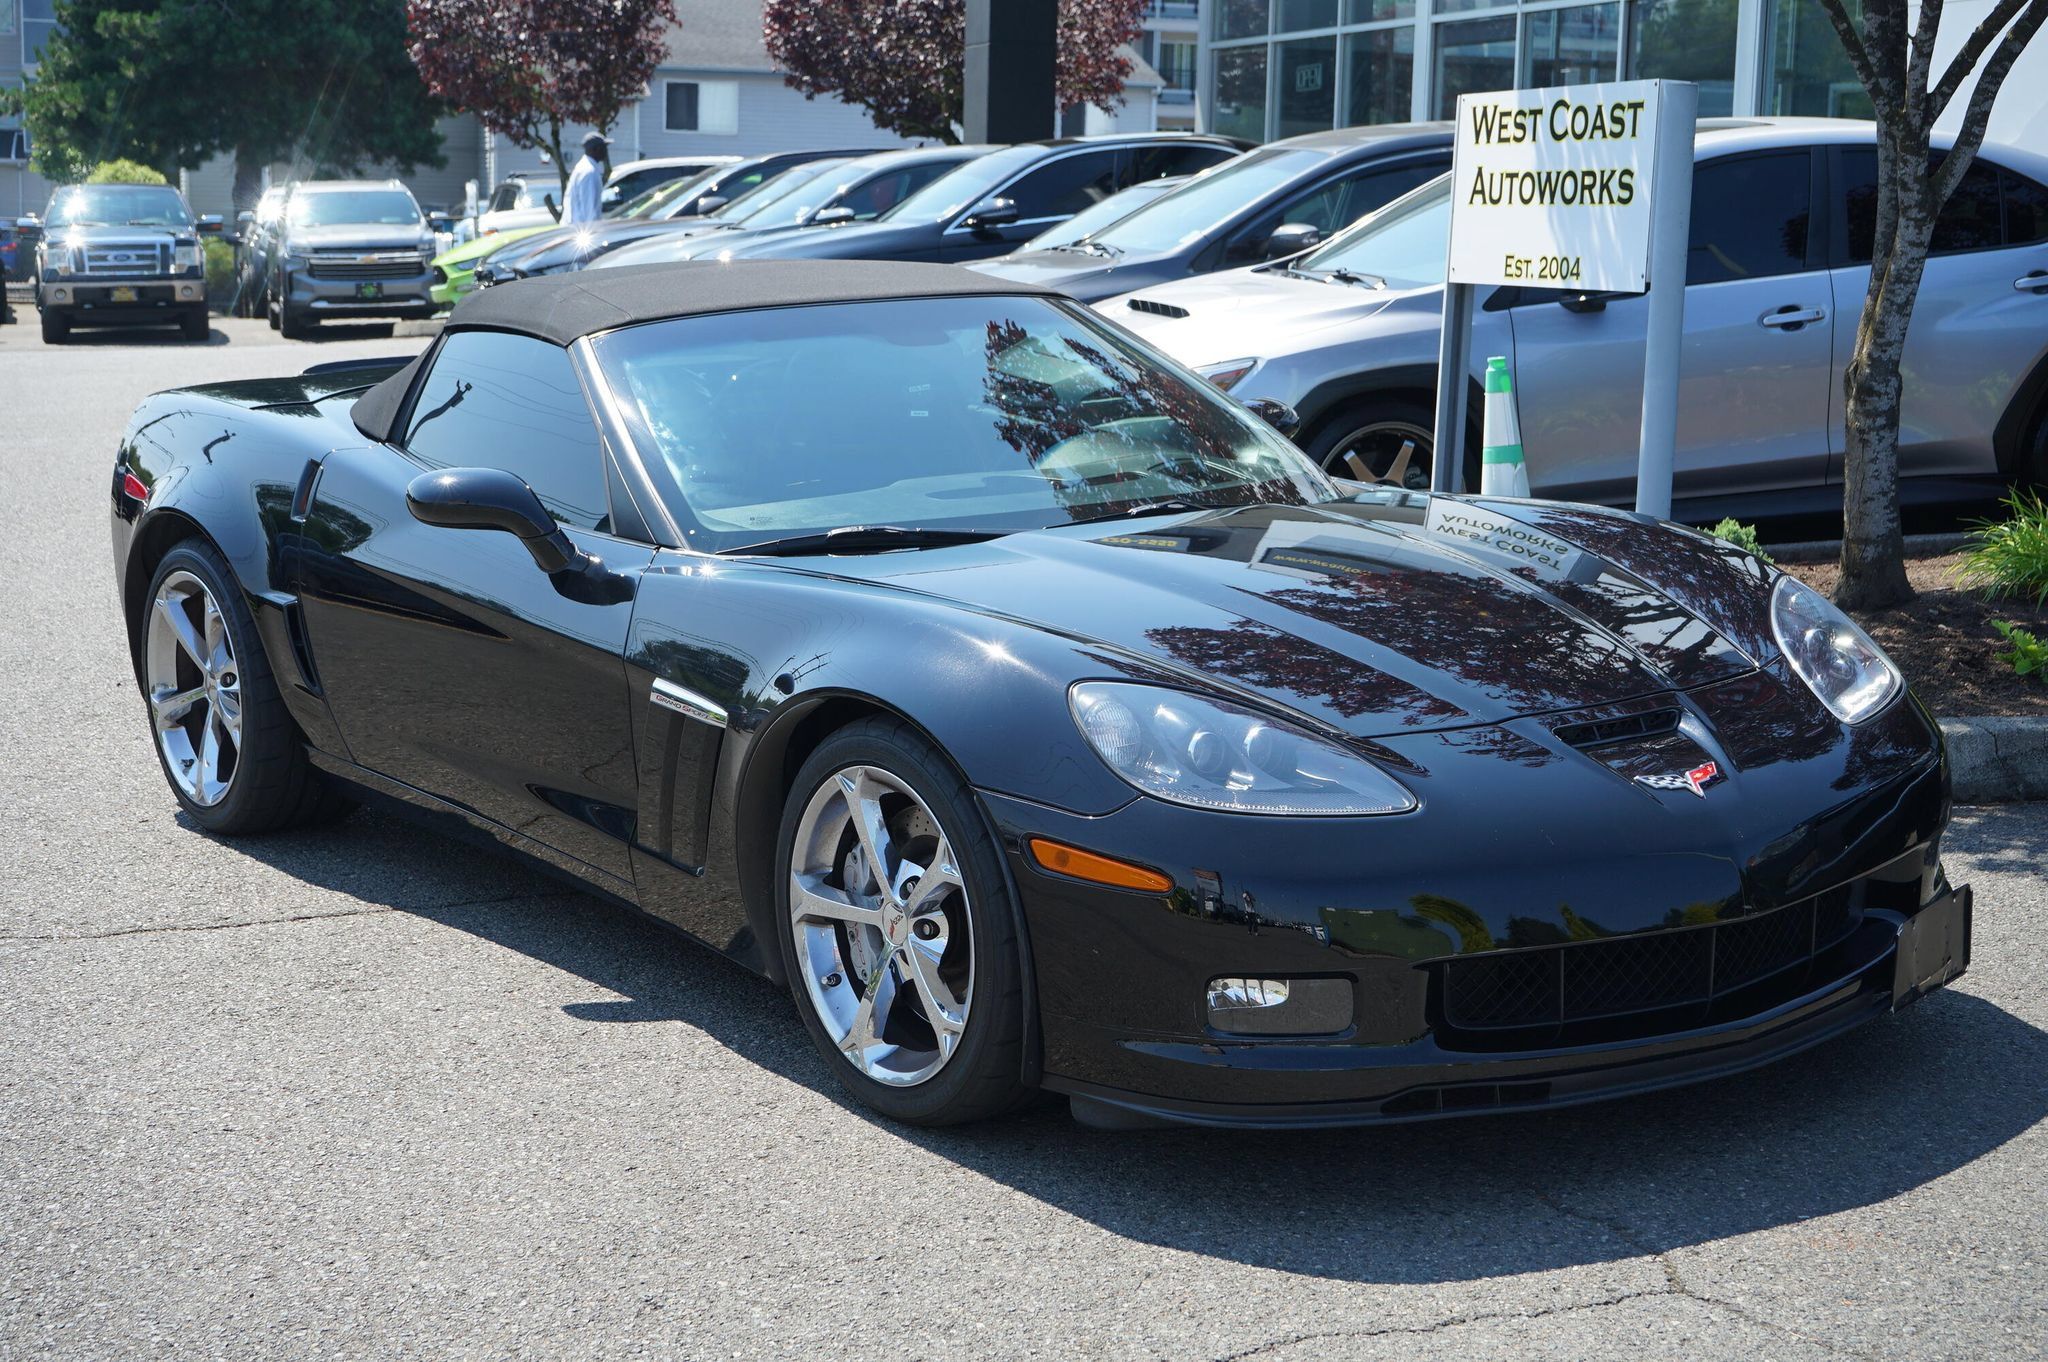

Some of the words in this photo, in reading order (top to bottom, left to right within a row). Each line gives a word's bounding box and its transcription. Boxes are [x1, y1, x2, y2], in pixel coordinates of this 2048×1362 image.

[1472, 103, 1543, 145] WEST
[1549, 98, 1645, 142] COAST
[1468, 166, 1635, 206] AUTOWORKS
[1538, 255, 1581, 281] 2004
